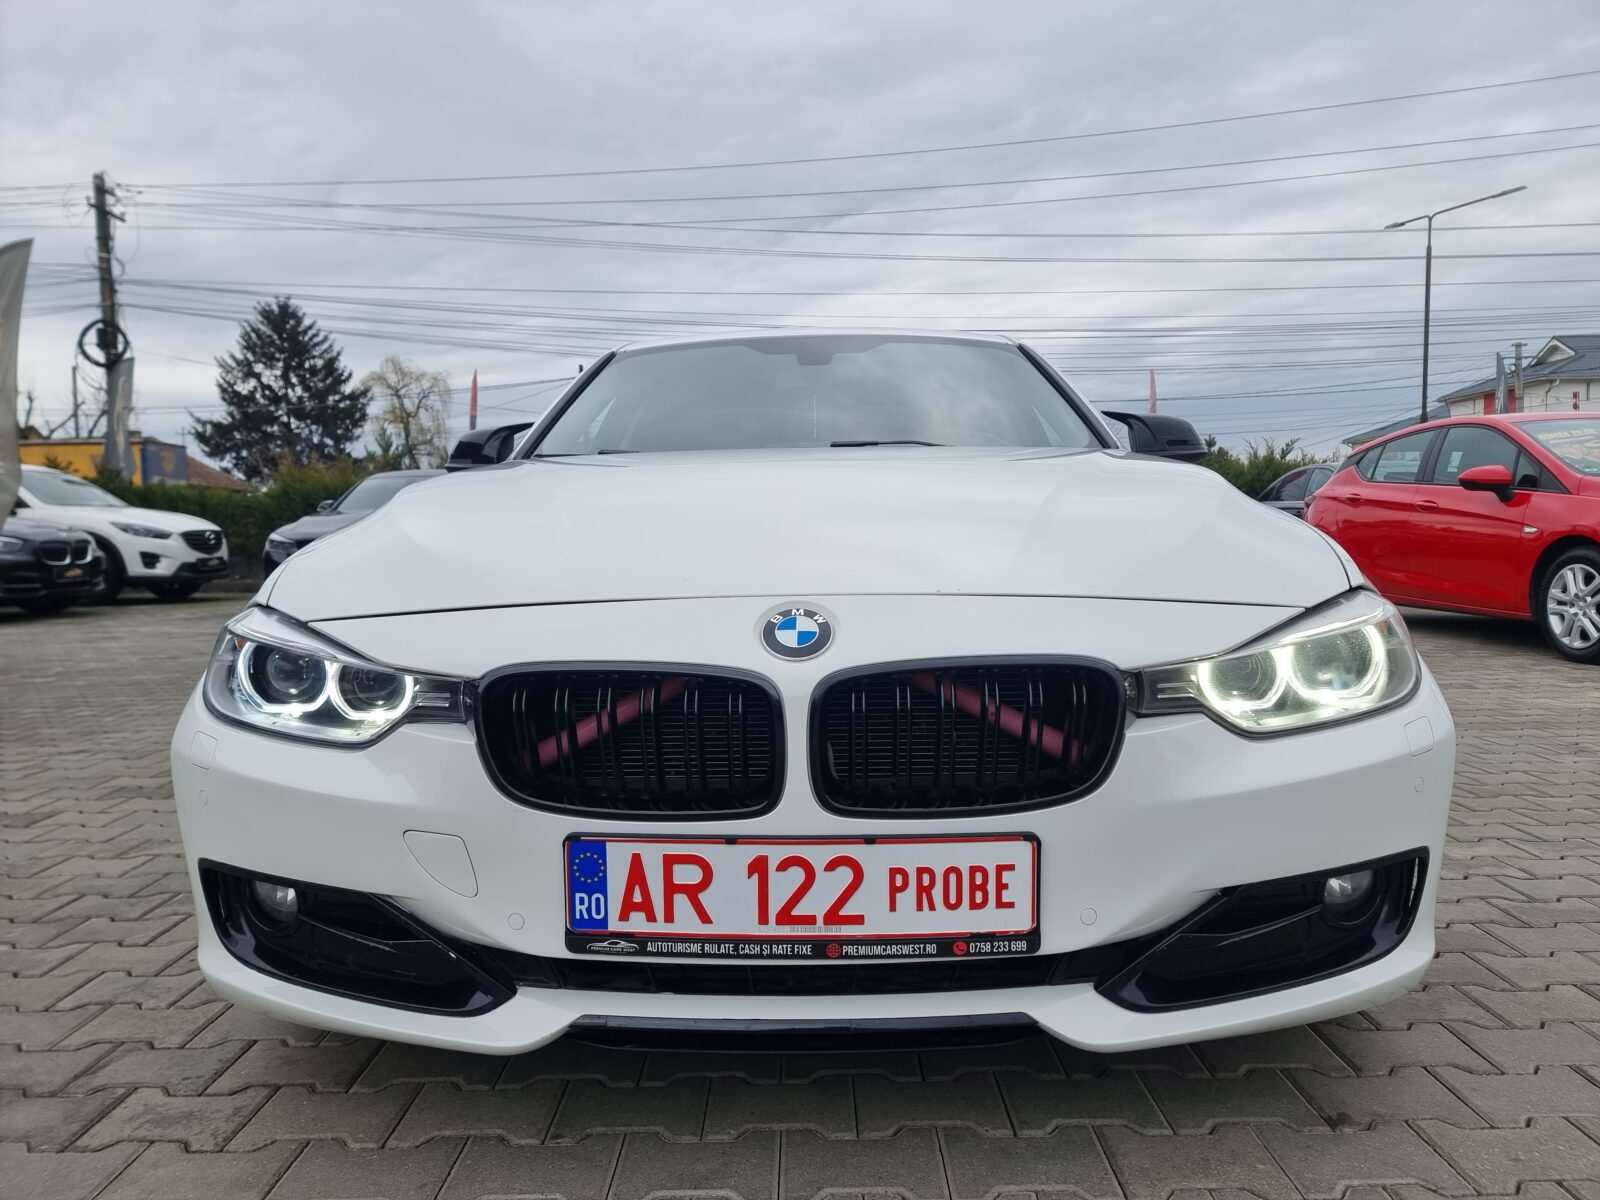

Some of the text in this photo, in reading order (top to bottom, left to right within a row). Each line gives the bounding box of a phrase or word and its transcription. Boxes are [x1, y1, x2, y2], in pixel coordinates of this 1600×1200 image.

[769, 608, 827, 624] BMW
[618, 852, 1016, 926] AR 122 PROBE
[575, 892, 605, 920] RO
[646, 941, 703, 954] AUTOTURISME
[704, 943, 737, 956] RULATE,
[738, 944, 761, 955] CASH
[772, 945, 792, 955] RATE
[794, 945, 813, 955] FIXE
[842, 943, 937, 956] PREMIUMCARSWEST.RO
[969, 940, 1027, 954] 0758 233 699
